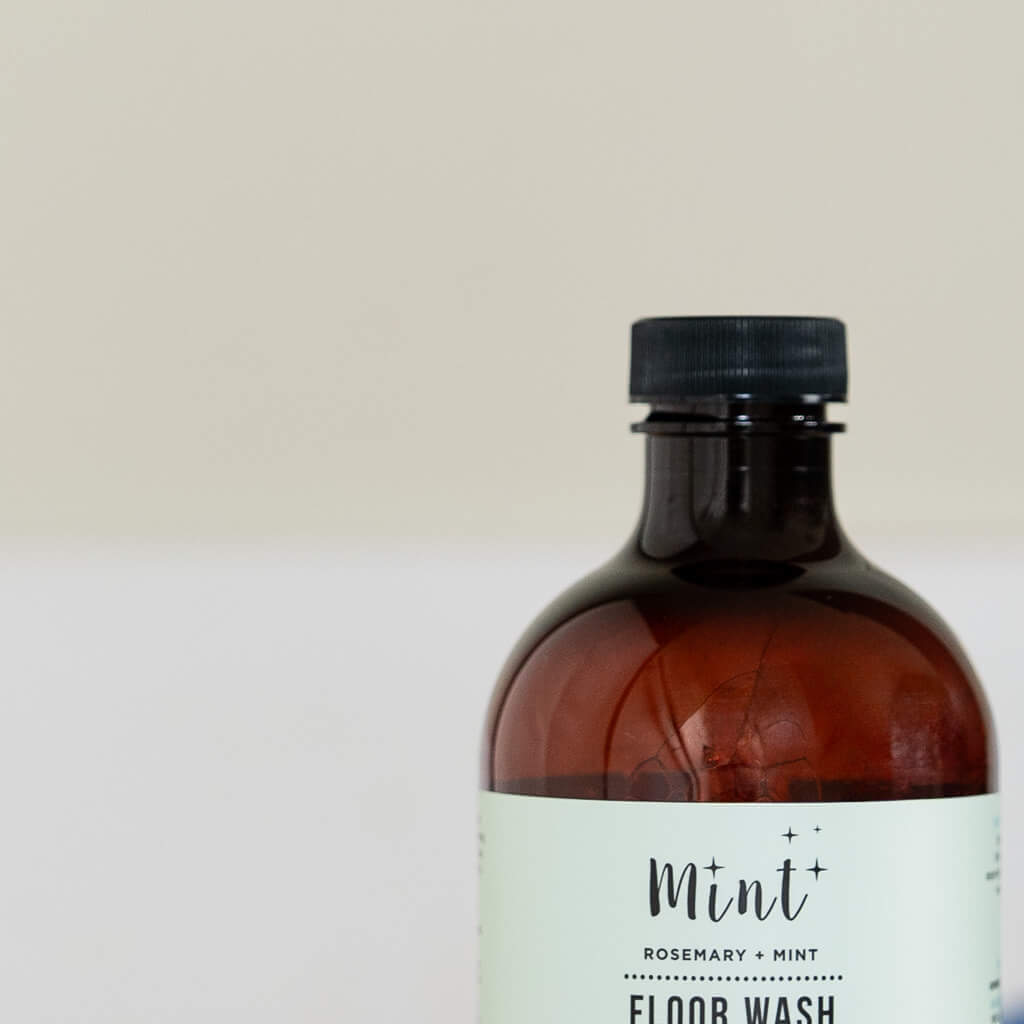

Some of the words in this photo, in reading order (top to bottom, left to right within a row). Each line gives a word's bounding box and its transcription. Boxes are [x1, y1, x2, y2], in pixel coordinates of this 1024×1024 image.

[648, 856, 808, 923] Mint
[643, 947, 747, 962] ROSEMARY
[754, 950, 765, 960] +
[773, 948, 819, 962] MINT
